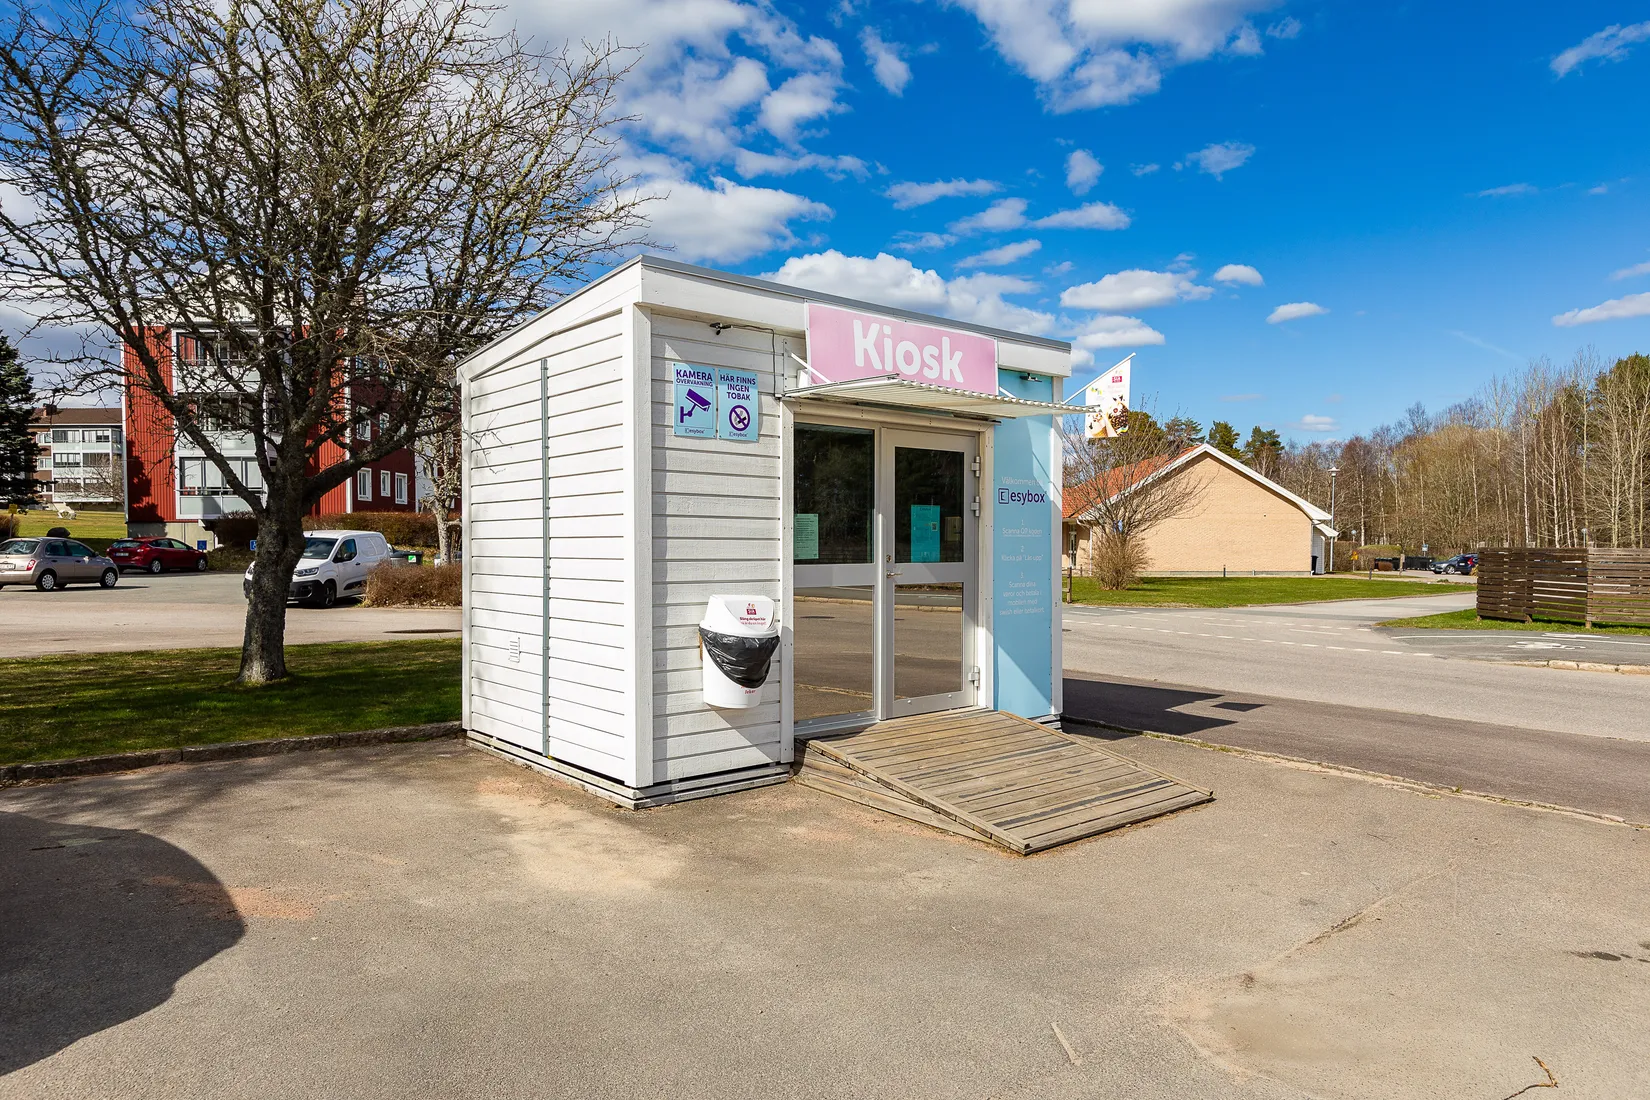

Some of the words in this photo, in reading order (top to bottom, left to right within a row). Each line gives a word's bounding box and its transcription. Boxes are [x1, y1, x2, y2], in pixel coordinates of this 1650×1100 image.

[853, 320, 964, 383] Kiosk
[676, 369, 713, 381] KAMERA
[720, 373, 735, 383] HÄR
[736, 376, 756, 385] FINNS
[676, 378, 713, 387] ÖVERVAKNING
[727, 384, 750, 392] INGEN
[726, 392, 751, 401] TOBAK
[1010, 490, 1045, 506] esybox
